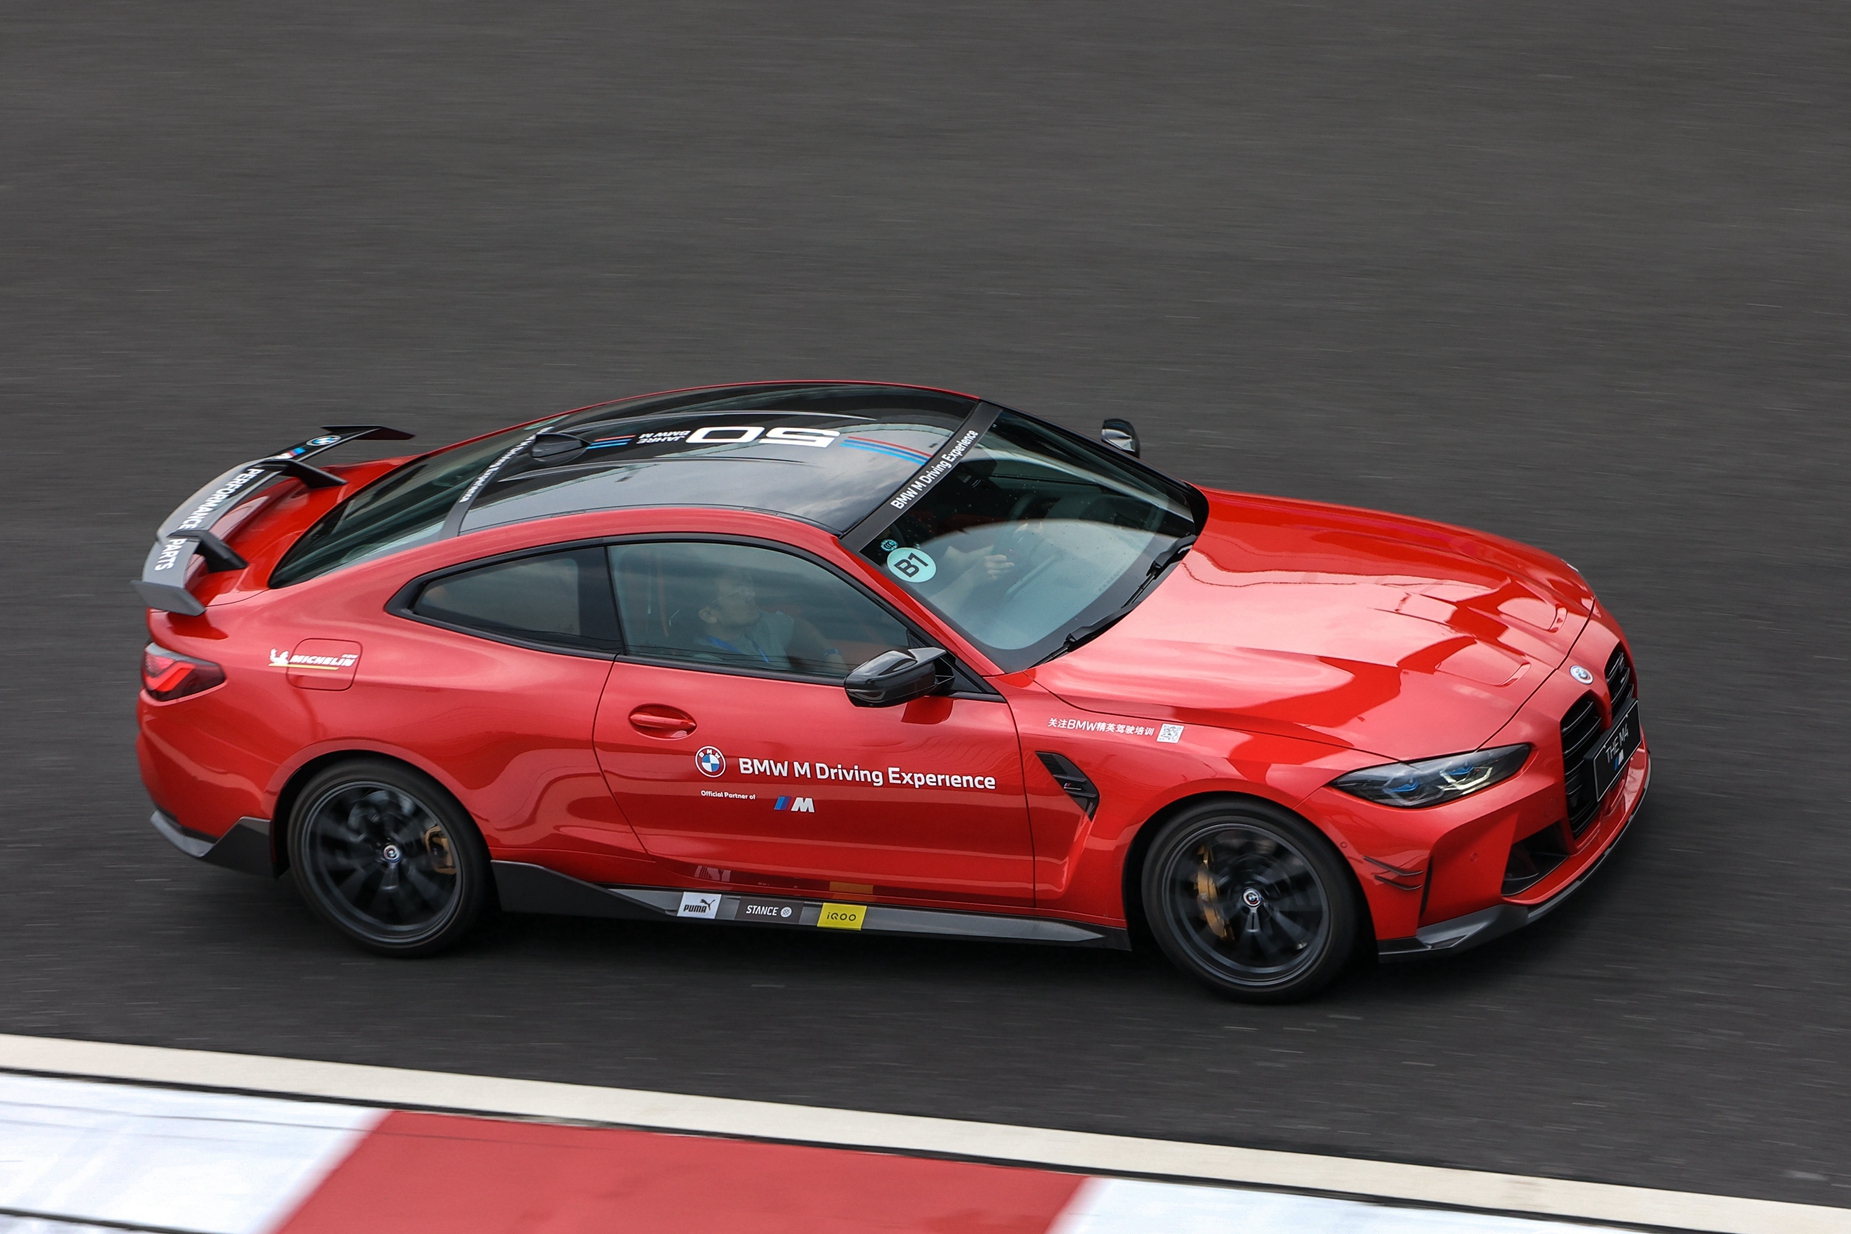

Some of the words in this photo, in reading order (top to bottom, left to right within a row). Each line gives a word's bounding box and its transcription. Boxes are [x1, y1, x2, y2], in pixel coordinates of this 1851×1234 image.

[685, 426, 841, 448] 50
[890, 487, 918, 510] BMW
[911, 480, 927, 492] M
[919, 460, 952, 484] Driving
[941, 430, 979, 462] Experience
[177, 468, 265, 531] PERFORMANCE
[154, 538, 188, 571] PARTS
[893, 552, 929, 579] B1
[289, 654, 356, 667] MICHELIN
[1047, 717, 1155, 736] 关注BMW精英驾驶培训
[699, 749, 721, 759] BMW
[1605, 735, 1620, 764] THE
[738, 757, 789, 777] BMW
[793, 761, 812, 778] M
[815, 762, 884, 787] Driving
[887, 766, 996, 790] Experience
[700, 789, 724, 798] Official
[724, 791, 748, 800] Partner
[790, 796, 815, 813] M
[683, 904, 707, 914] PUMA
[745, 905, 779, 916] STANCE
[826, 911, 857, 922] iQOO
